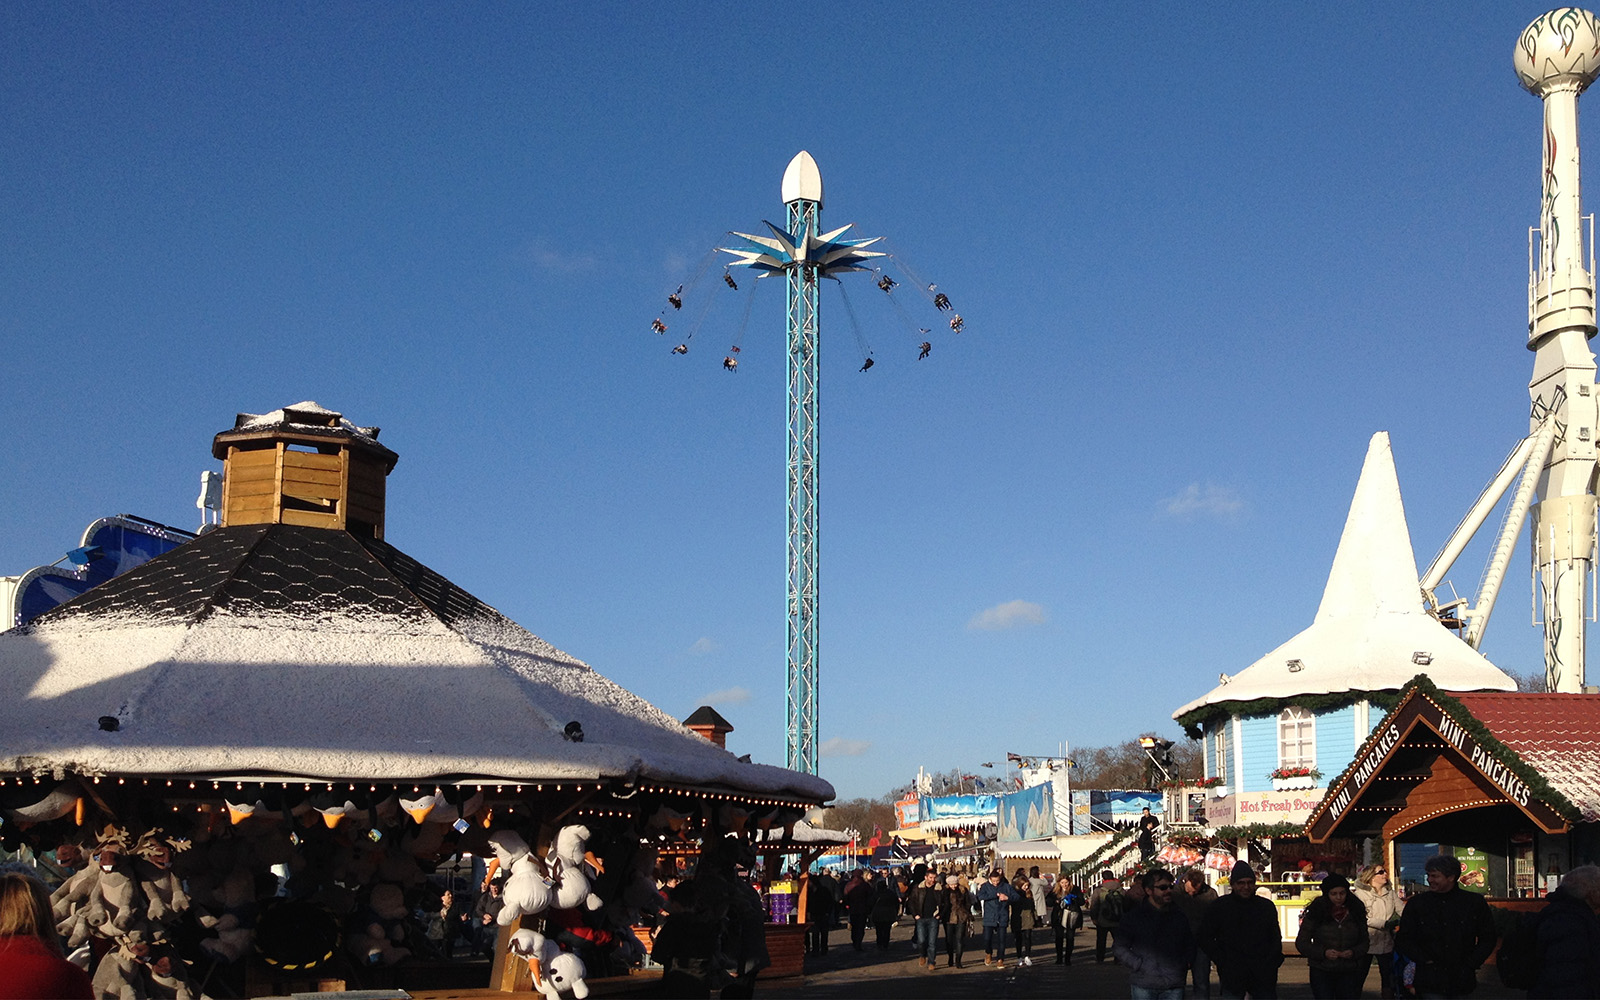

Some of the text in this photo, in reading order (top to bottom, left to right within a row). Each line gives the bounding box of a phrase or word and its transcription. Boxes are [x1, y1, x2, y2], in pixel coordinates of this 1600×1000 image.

[1240, 801, 1260, 813] Hot
[1261, 799, 1292, 813] Fresh
[1329, 723, 1400, 821] MINI PANCAKES
[1439, 715, 1530, 807] MINI PANCAKES
